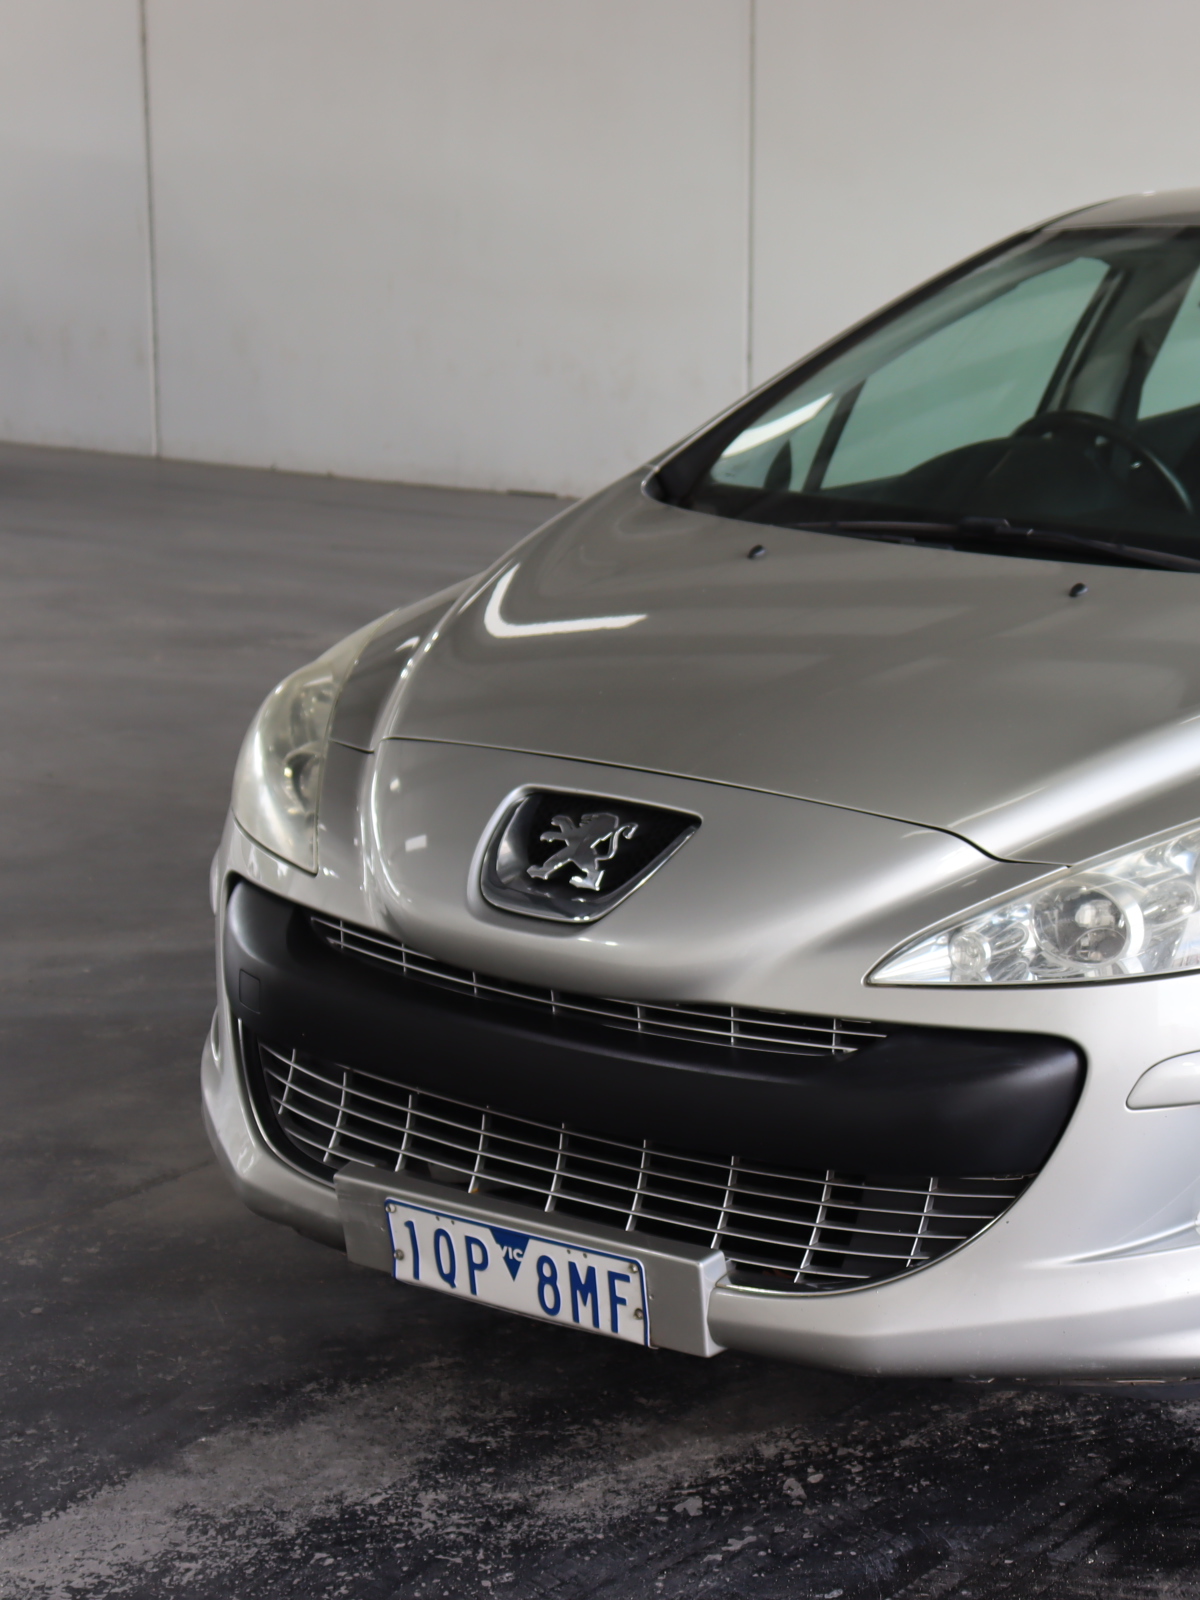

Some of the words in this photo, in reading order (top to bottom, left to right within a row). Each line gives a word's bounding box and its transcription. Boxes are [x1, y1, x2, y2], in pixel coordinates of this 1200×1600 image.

[404, 1220, 489, 1296] 1QP
[536, 1254, 631, 1334] 8MF
[498, 1244, 524, 1262] VIC
